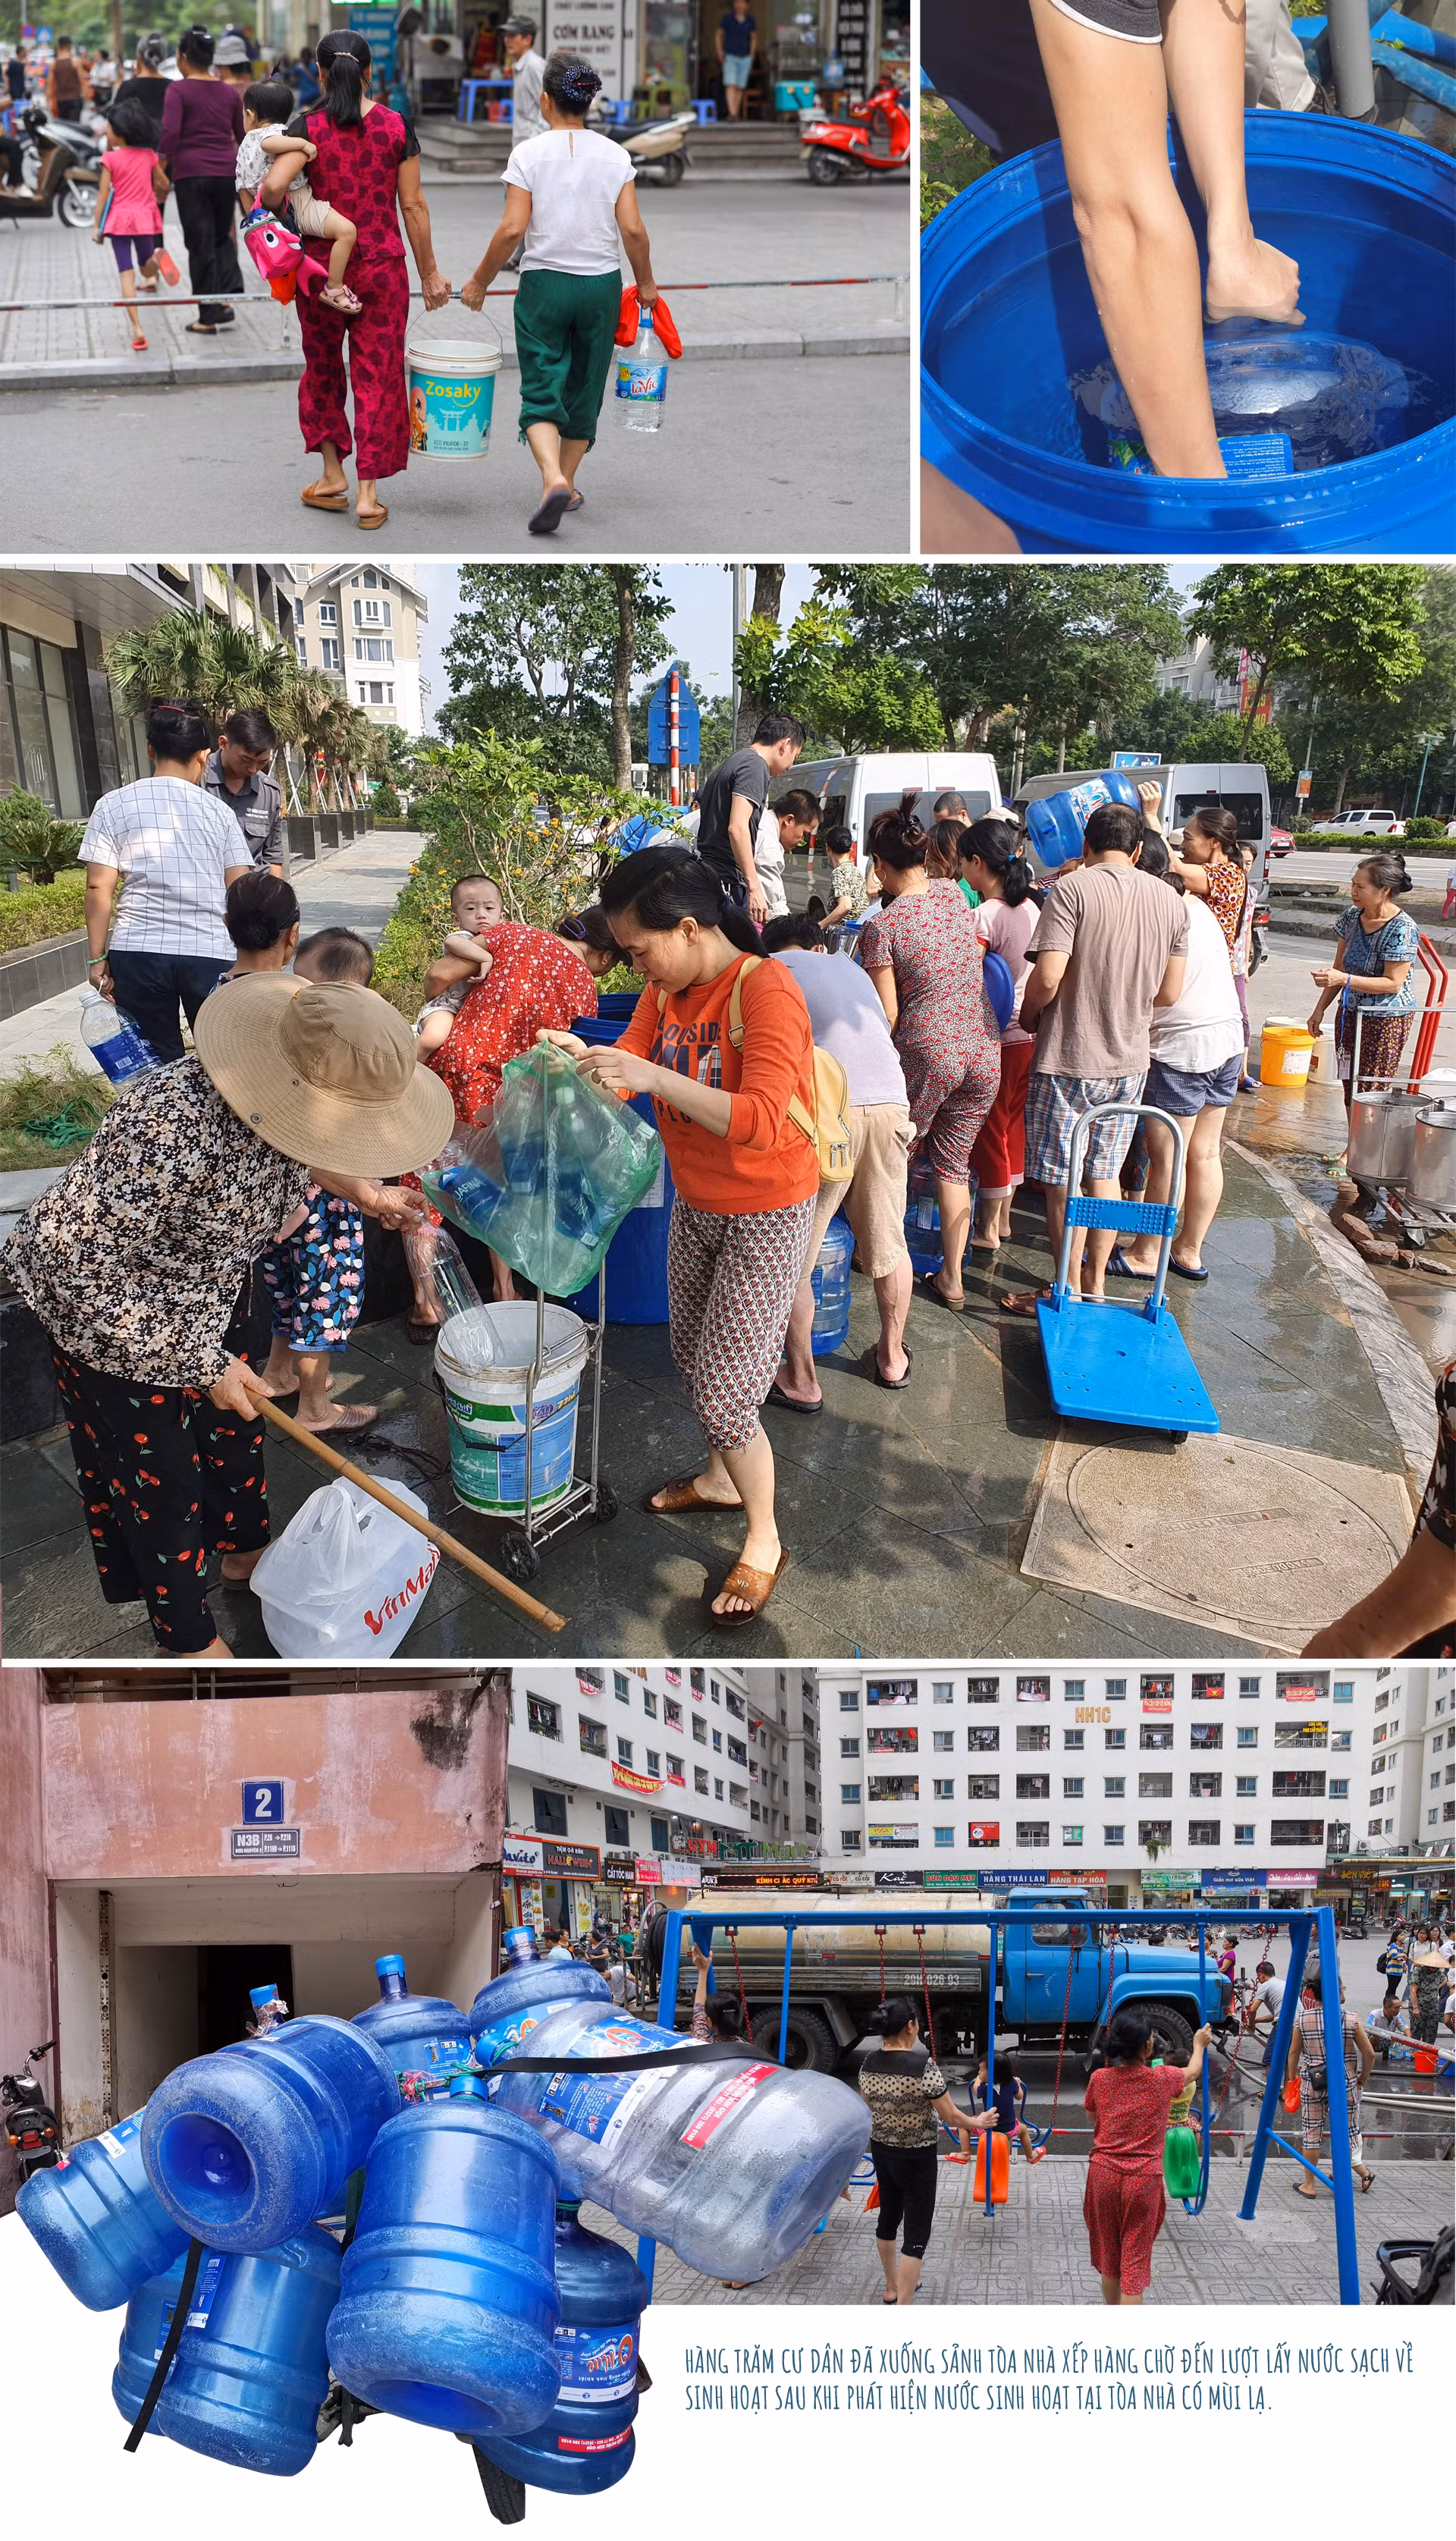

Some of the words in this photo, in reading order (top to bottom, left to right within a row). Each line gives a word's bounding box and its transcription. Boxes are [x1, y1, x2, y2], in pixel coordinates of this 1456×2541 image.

[426, 381, 481, 402] Zosaky
[1075, 1706, 1111, 1723] HH1C
[255, 1789, 271, 1817] 2
[237, 1834, 259, 1846] N3B
[687, 1839, 717, 1853] GYM
[763, 1842, 808, 1859] Mart
[617, 1867, 625, 1879] TÓC
[626, 1870, 634, 1880] NAM
[984, 1874, 1006, 1883] HÀNG
[1009, 1874, 1027, 1883] THÁI
[1359, 1869, 1377, 1879] VIỆT
[948, 1974, 959, 1986] 93
